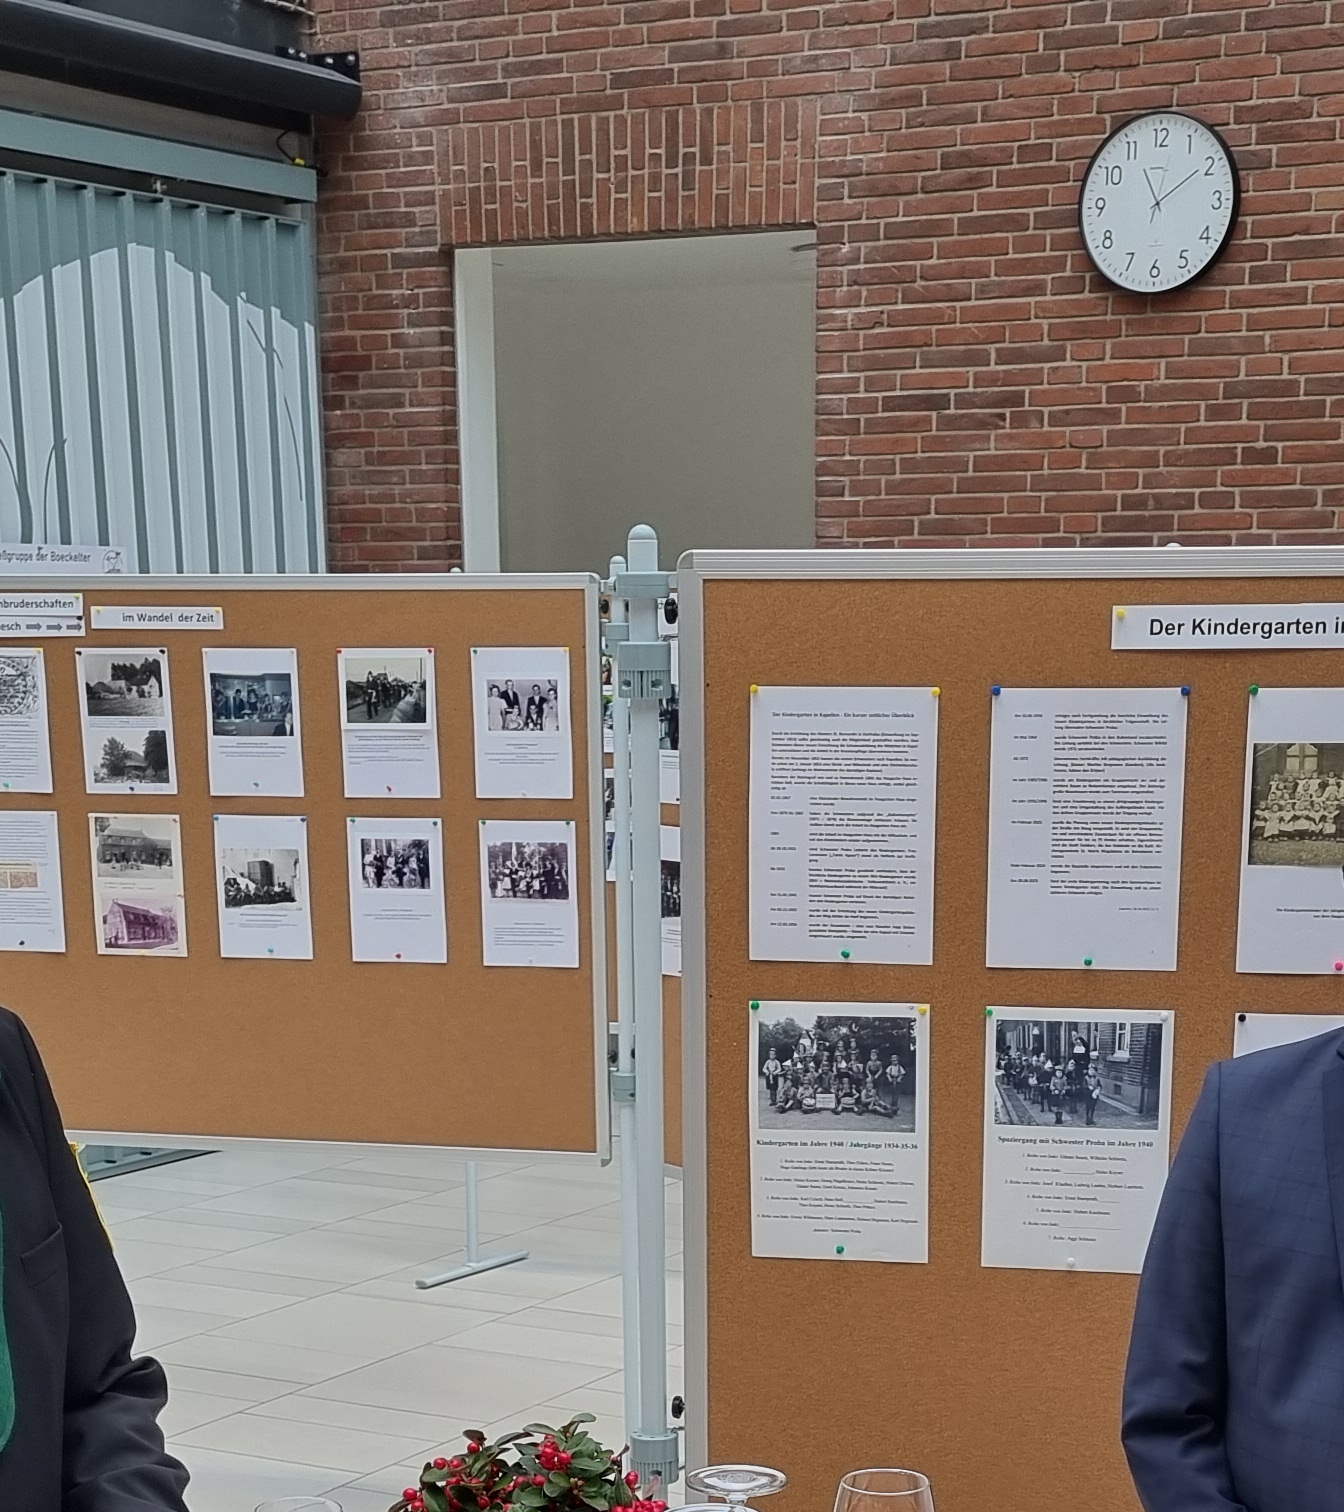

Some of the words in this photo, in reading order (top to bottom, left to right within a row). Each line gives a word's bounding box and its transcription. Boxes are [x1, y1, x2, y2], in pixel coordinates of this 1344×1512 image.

[1153, 127, 1170, 148] 12
[1187, 134, 1192, 154] 1
[1126, 140, 1138, 161] 11
[1105, 165, 1122, 186] 10
[1204, 156, 1215, 176] 2
[1095, 197, 1106, 218] 9
[1211, 190, 1223, 210] 3
[1102, 229, 1114, 250] 8
[1199, 225, 1212, 245] 4
[1125, 252, 1136, 272] 7
[1149, 259, 1161, 279] 6
[1177, 249, 1190, 269] 5
[35, 550, 49, 562] der
[122, 612, 135, 623] im
[136, 612, 174, 623] Wandel
[177, 612, 194, 623] der
[196, 613, 215, 623] Zeit
[1149, 618, 1185, 636] Der
[1191, 617, 1327, 641] Kindergarten
[756, 1138, 799, 1148] Kindergarten
[809, 1139, 828, 1148] Jahre
[849, 1140, 882, 1150] Jahrgänge
[997, 1135, 1038, 1146] Spaziergang
[1039, 1137, 1050, 1145] mit
[1051, 1137, 1085, 1146] Schwester
[1116, 1139, 1137, 1148] Jahre
